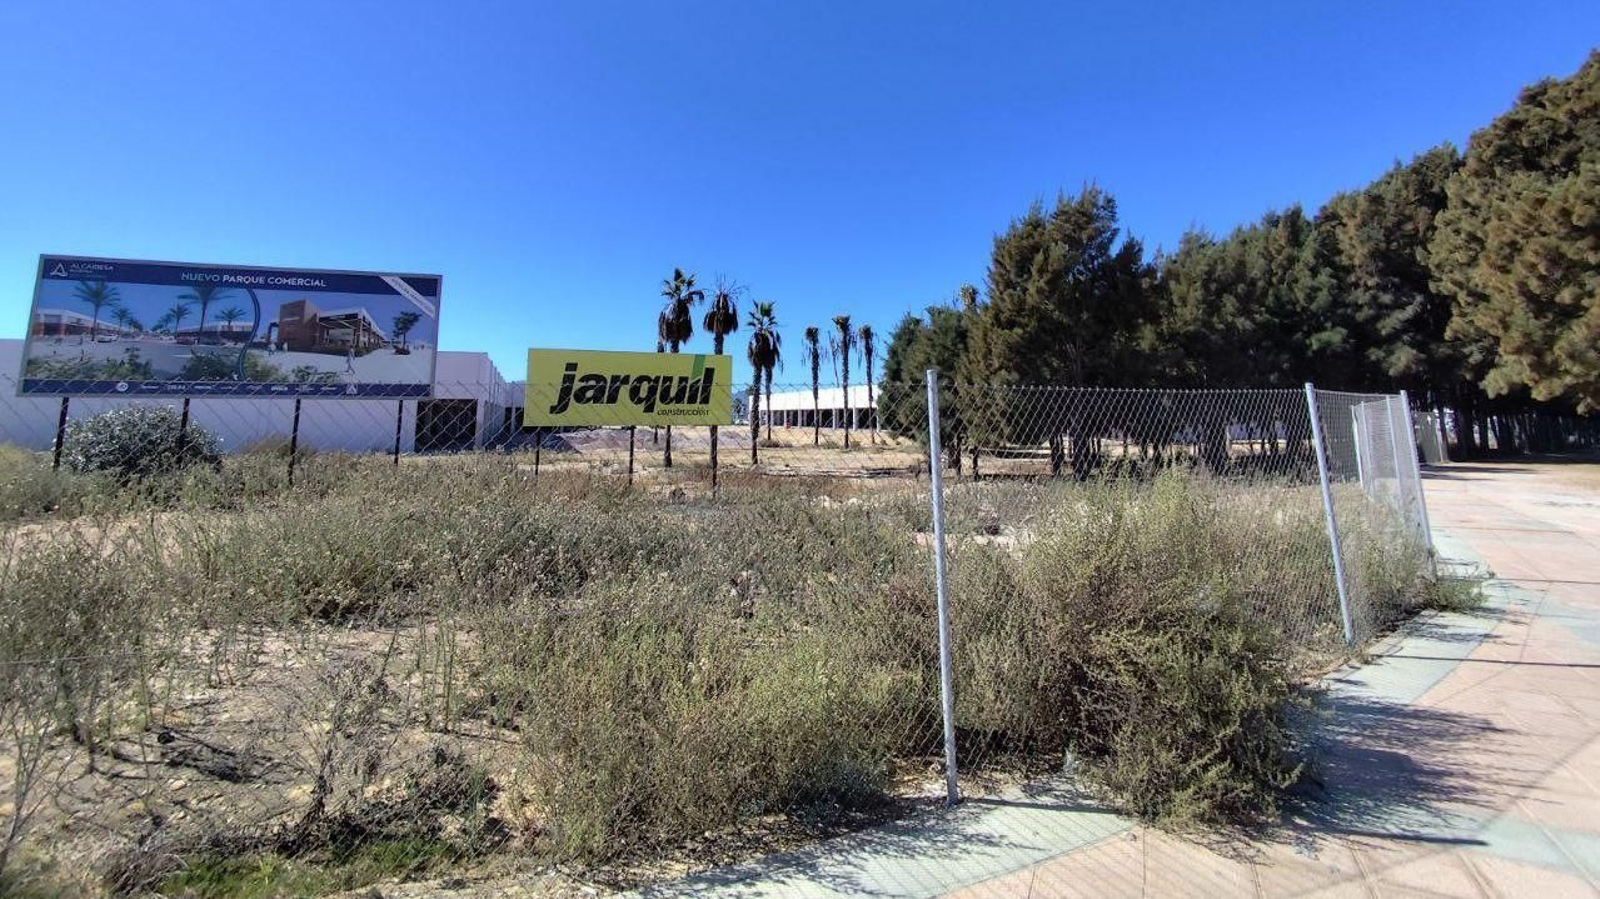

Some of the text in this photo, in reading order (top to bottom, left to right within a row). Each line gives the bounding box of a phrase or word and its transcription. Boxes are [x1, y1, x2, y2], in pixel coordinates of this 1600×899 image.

[181, 272, 327, 287] NUEVO PARQUE COMERCIAL
[549, 360, 715, 415] jarquil
